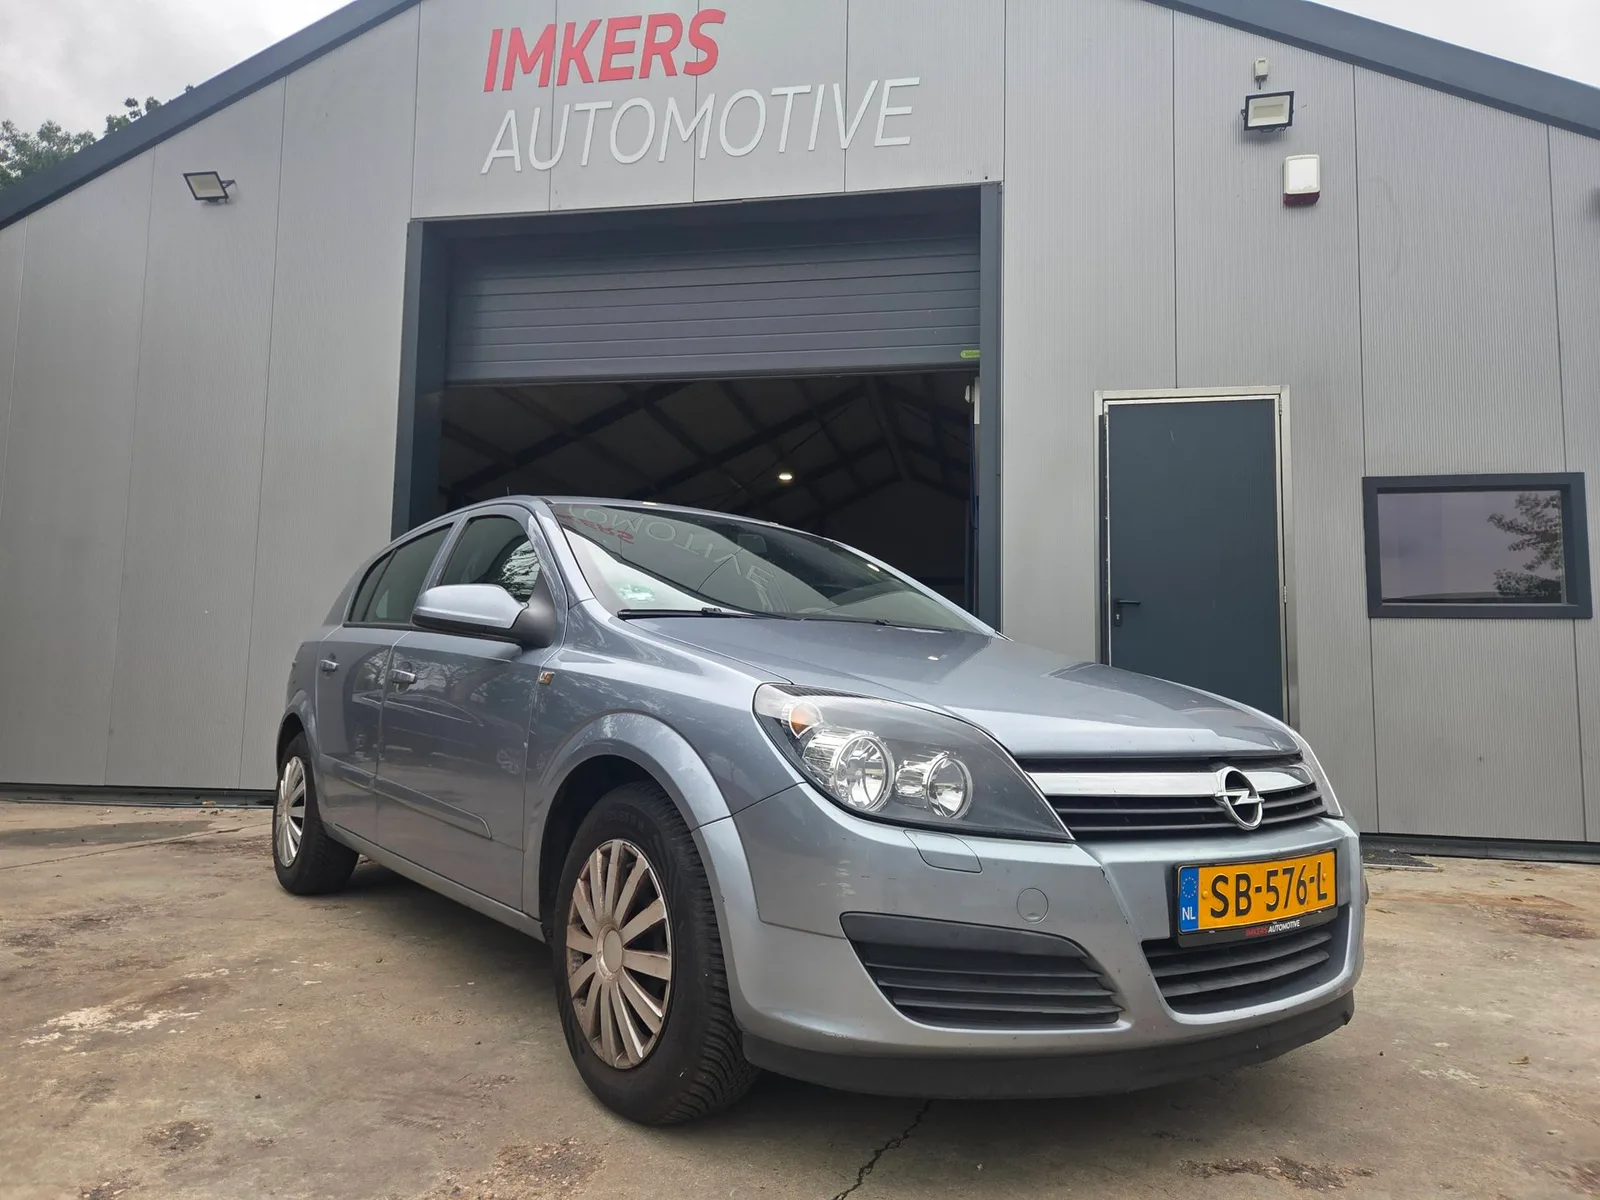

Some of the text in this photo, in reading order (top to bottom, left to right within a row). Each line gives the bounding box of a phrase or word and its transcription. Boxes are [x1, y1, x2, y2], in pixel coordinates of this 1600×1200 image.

[483, 8, 726, 92] IMKERS
[480, 77, 921, 174] AUTOMOTIVE
[1182, 907, 1196, 921] NL
[1210, 861, 1328, 919] SB-576-L
[1268, 919, 1301, 934] AUTOMOTIVE
